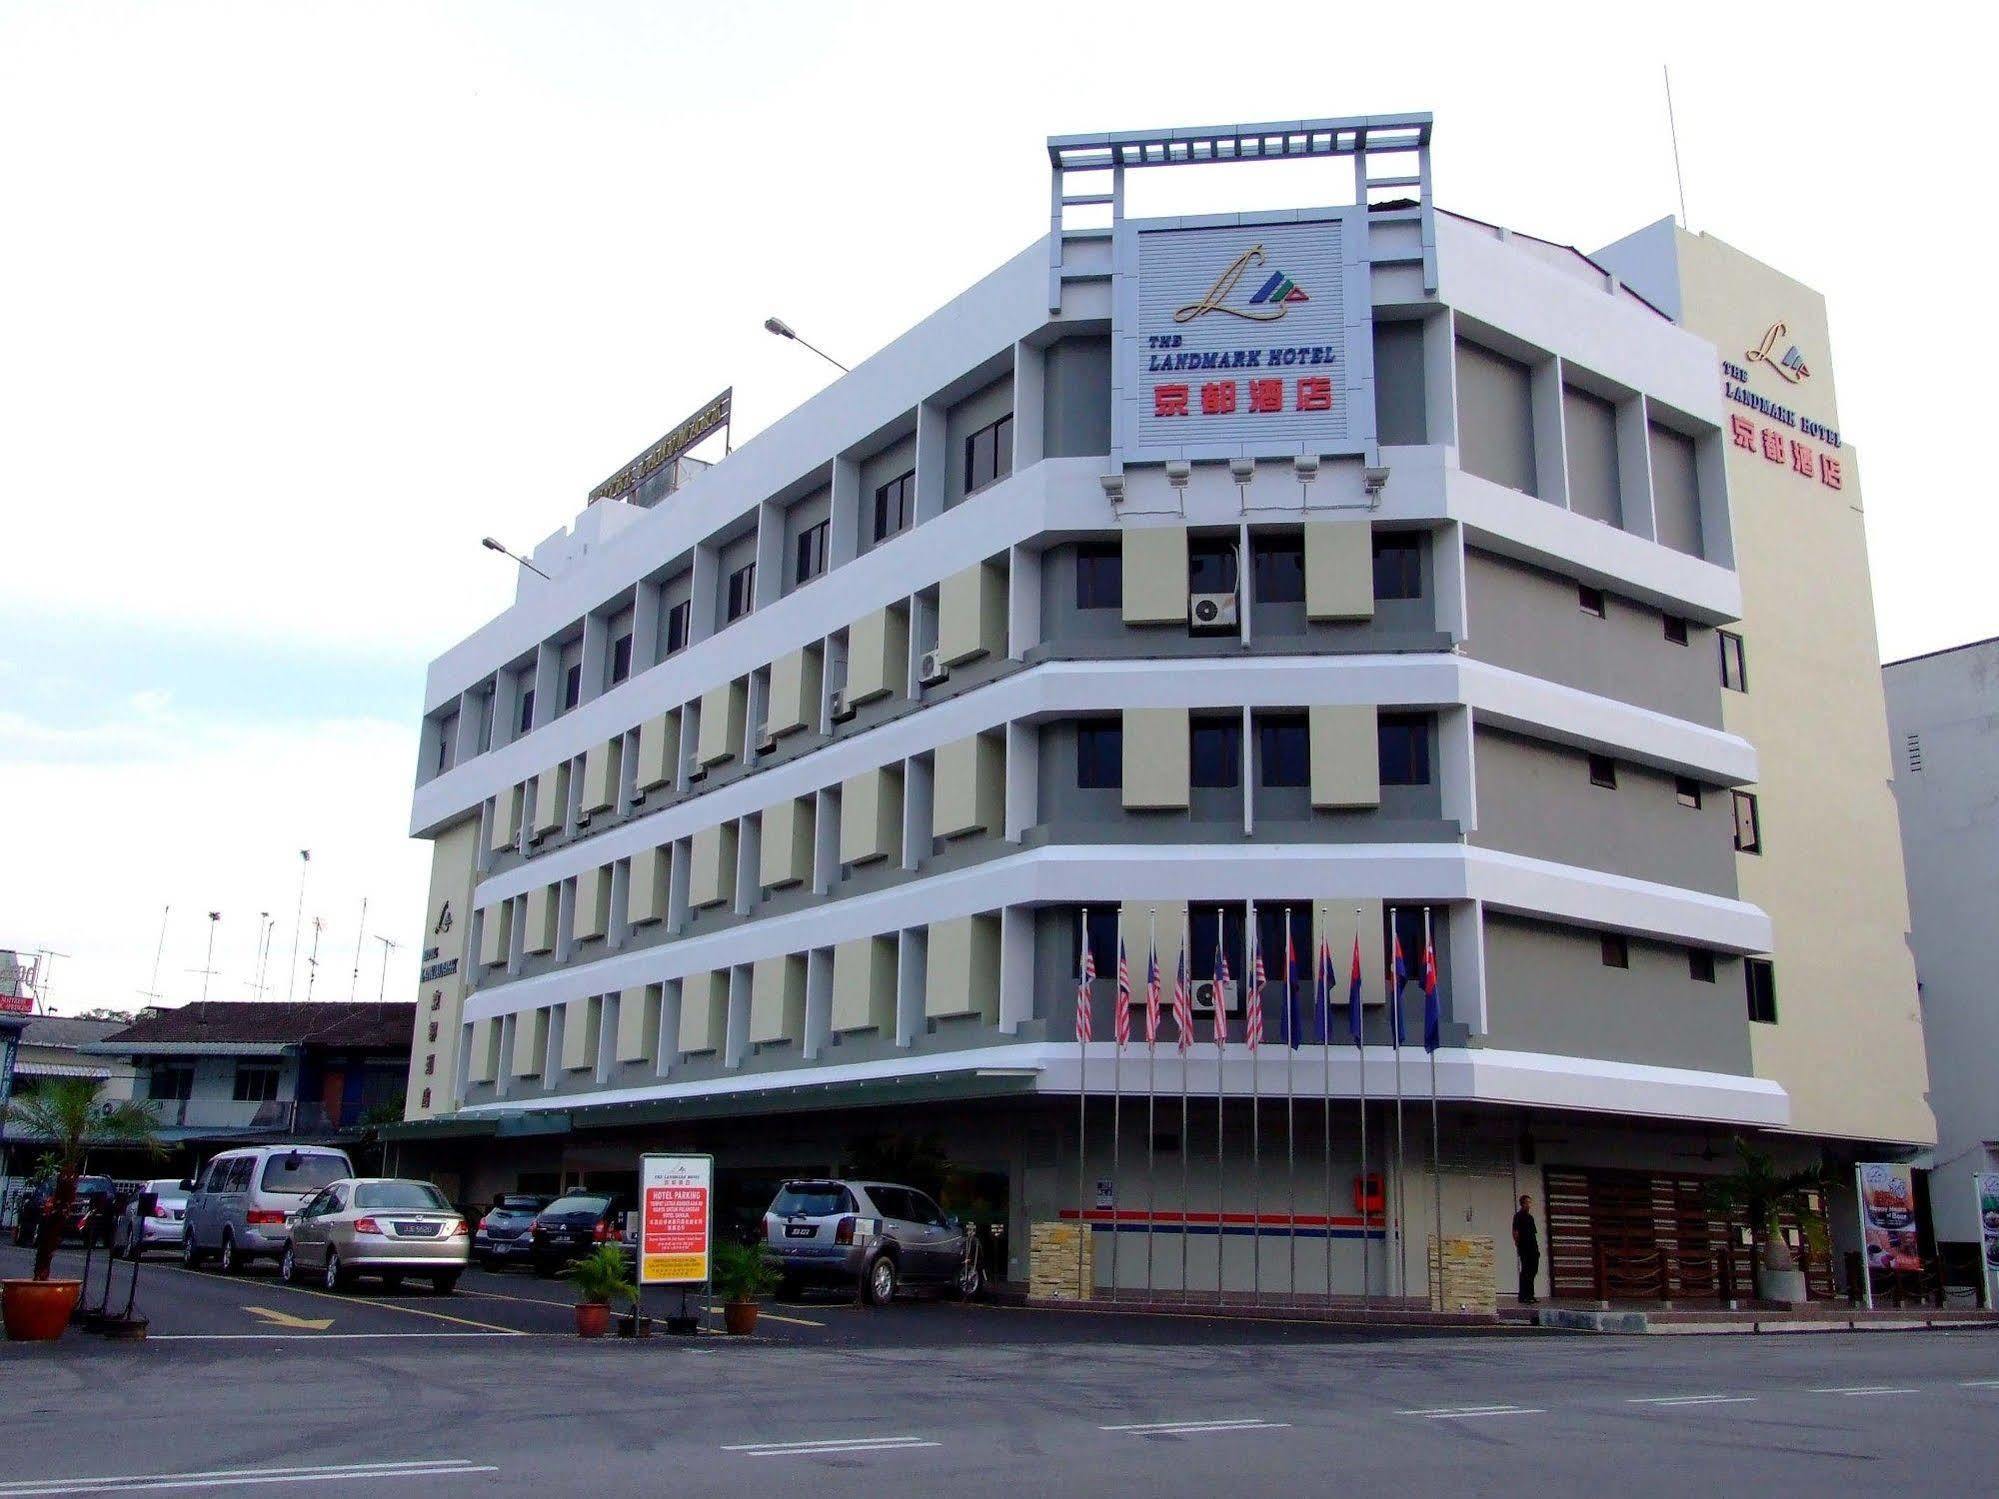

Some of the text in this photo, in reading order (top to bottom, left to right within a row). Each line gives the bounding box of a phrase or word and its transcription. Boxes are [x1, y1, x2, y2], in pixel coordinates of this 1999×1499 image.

[1149, 335, 1182, 349] THE
[1149, 346, 1336, 372] LANDMARK HOTEL
[1722, 360, 1748, 383] THE
[1153, 376, 1332, 417] 京都酒店
[1725, 381, 1842, 448] LANDMARK HOTEL
[1731, 413, 1842, 490] 京都酒店
[653, 1191, 701, 1200] HOTEL PARKING
